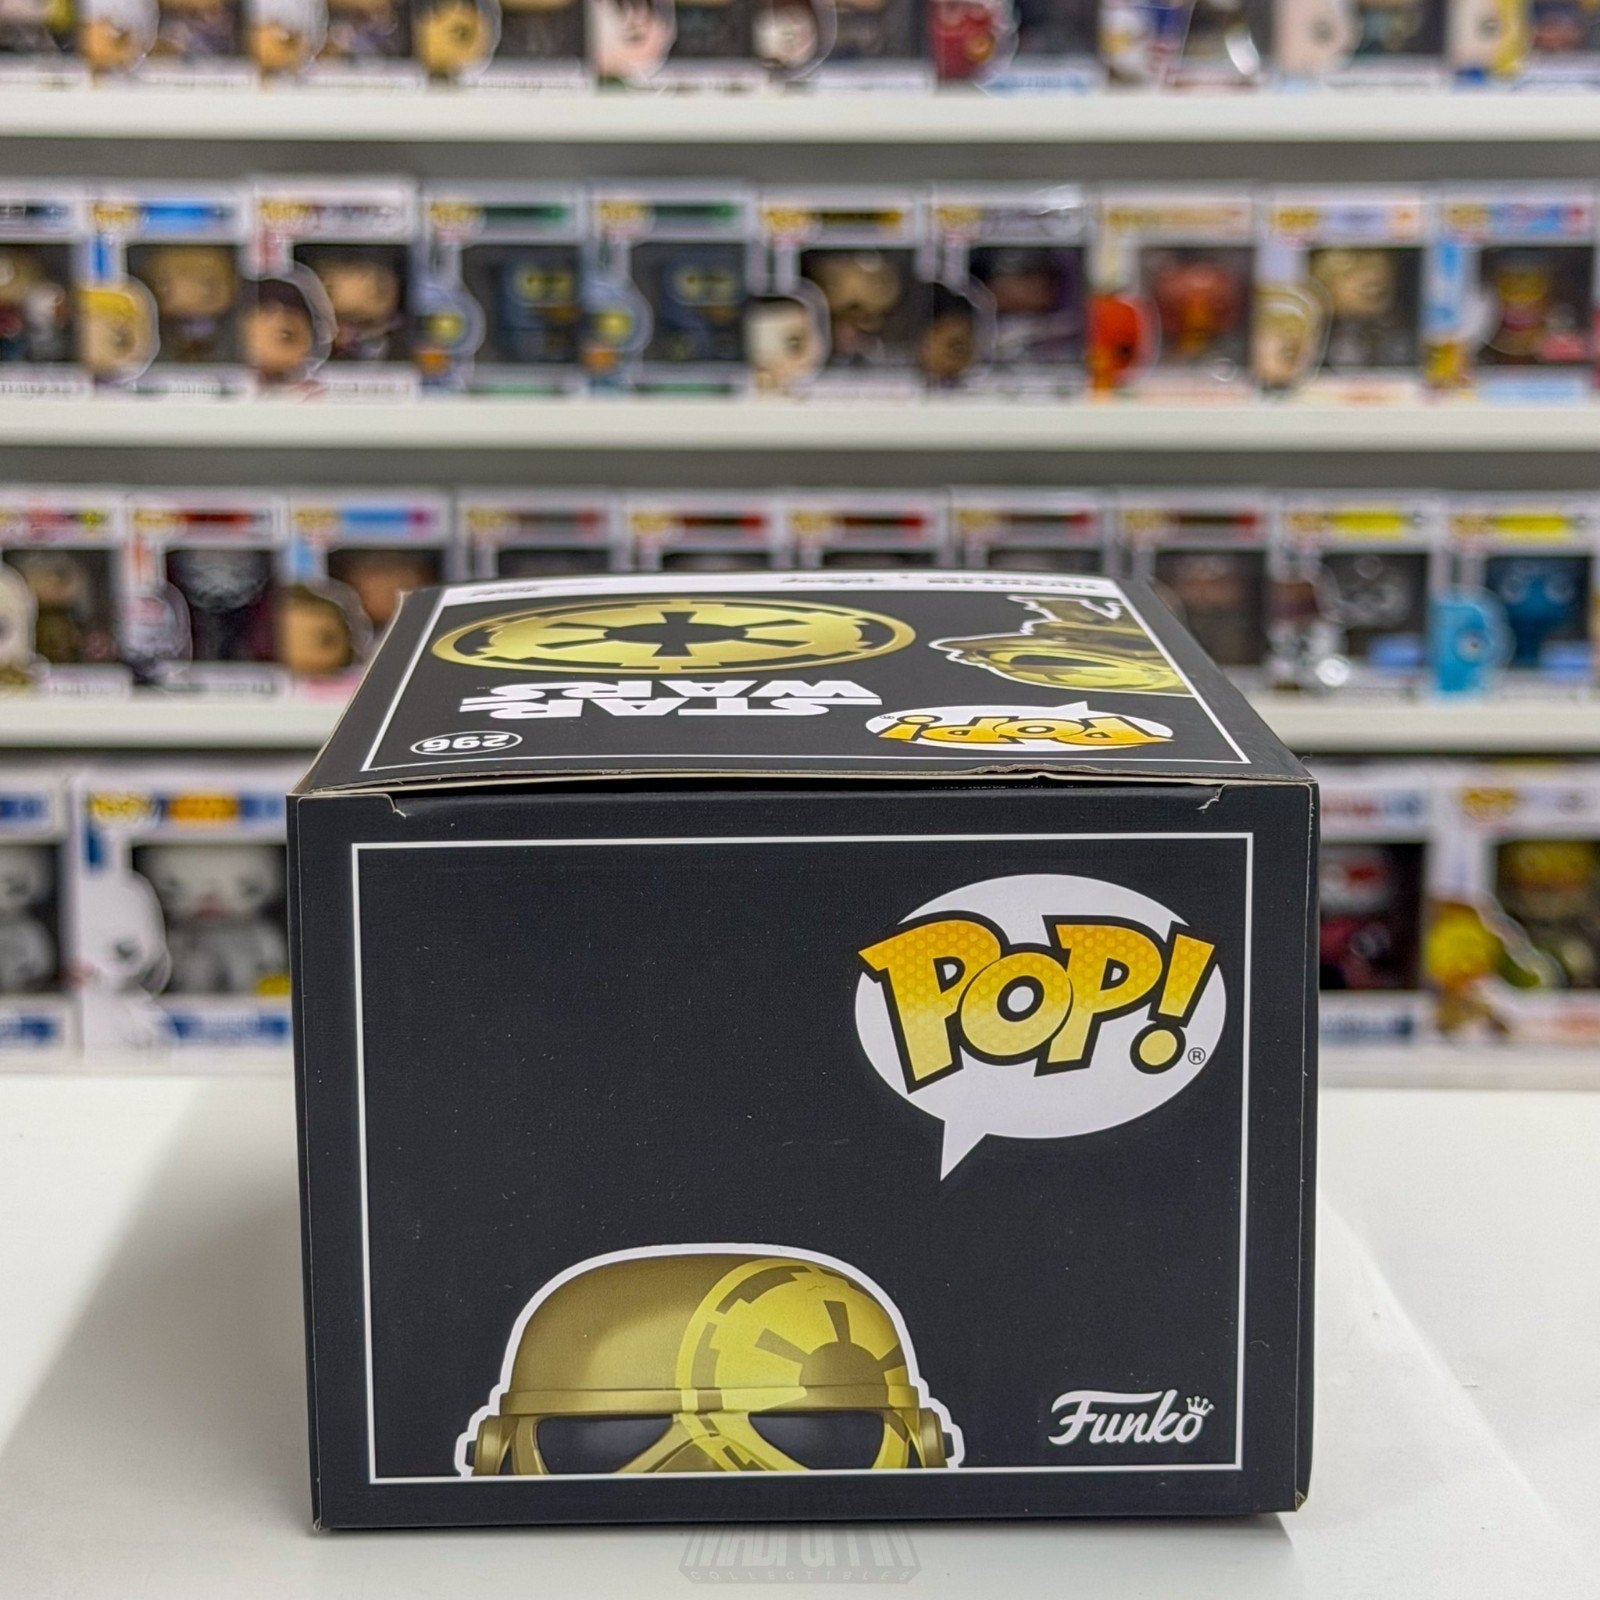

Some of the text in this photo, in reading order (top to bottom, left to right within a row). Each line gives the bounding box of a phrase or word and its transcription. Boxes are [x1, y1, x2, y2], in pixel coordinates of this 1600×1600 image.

[463, 680, 879, 700] WARS
[458, 697, 883, 719] STAR
[422, 735, 510, 751] 296
[877, 715, 1176, 746] POP!
[855, 914, 1218, 1090] POP!
[1048, 1389, 1205, 1446] Funko
